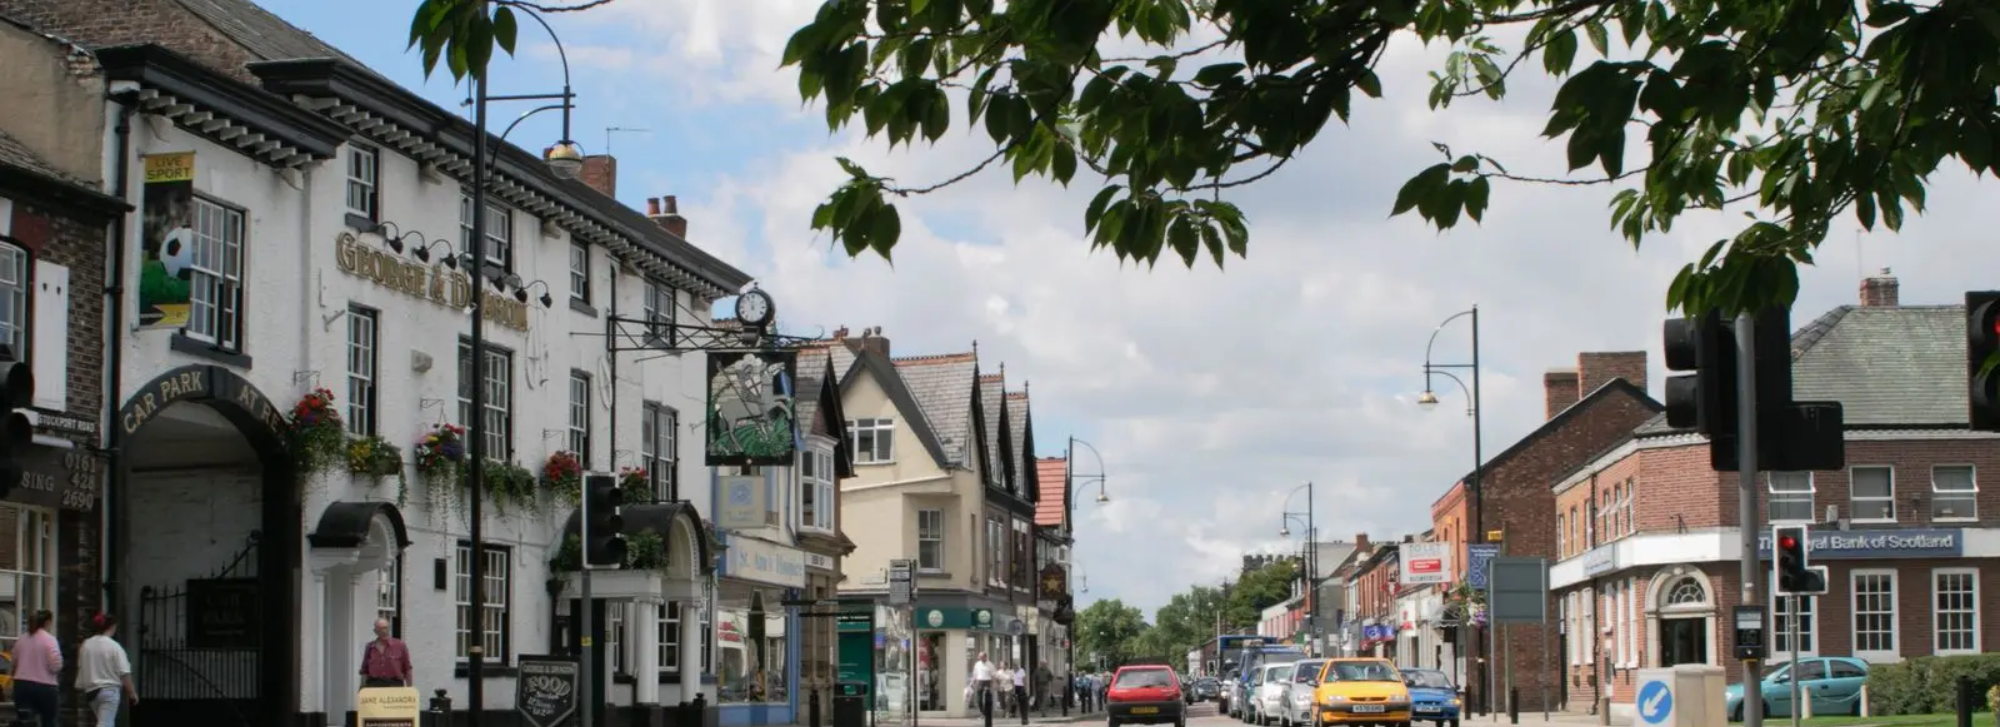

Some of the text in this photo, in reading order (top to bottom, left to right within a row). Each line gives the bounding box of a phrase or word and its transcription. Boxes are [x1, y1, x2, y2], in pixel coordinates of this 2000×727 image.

[155, 156, 181, 167] LIVE
[147, 167, 191, 180] SPORT
[335, 231, 528, 332] GEORGE & DAGON
[124, 392, 158, 434] CAR
[160, 371, 203, 402] PARK
[38, 413, 95, 433] STOCKPORT ROAD
[64, 452, 96, 473] 0161
[71, 472, 96, 491] 428
[63, 489, 95, 511] 2690
[1831, 534, 1869, 549] Bank
[1871, 534, 1887, 548] of
[1888, 533, 1954, 549] Scotland
[525, 674, 571, 697] FOOD
